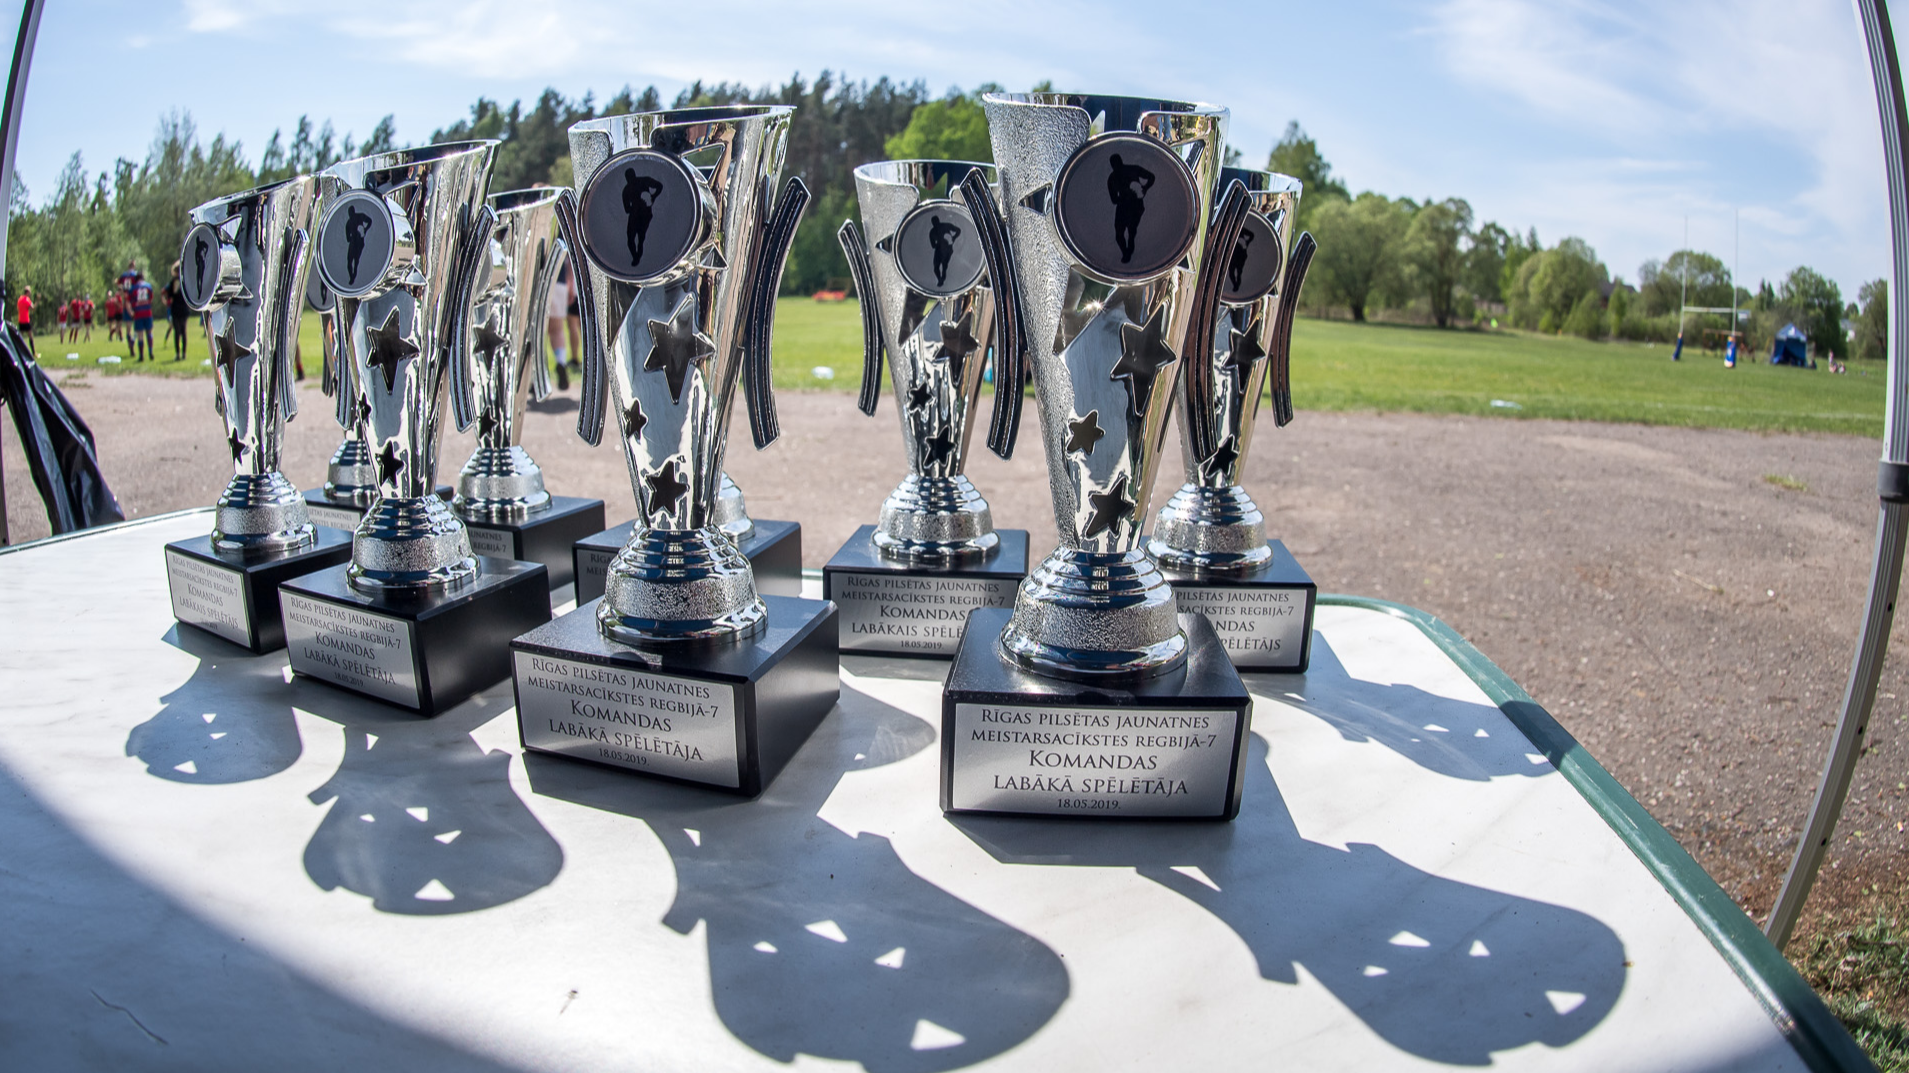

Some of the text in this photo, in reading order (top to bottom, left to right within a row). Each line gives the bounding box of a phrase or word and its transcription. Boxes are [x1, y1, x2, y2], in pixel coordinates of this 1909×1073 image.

[847, 576, 1000, 593] RĪGAS PILSĒTAS JAUNATNES
[842, 590, 1006, 608] MEISTARSACĪKSTES REGBIJĀ-7
[1176, 591, 1290, 603] PILSĒTAS JAUNATNES
[880, 605, 966, 621] KOMANDAS
[1240, 605, 1295, 618] REGBIJĀ-7
[348, 612, 395, 633] JAUNATNES
[852, 621, 918, 637] LABĀKAIS
[1215, 620, 1255, 632] NDAS
[315, 631, 375, 660] KOMANDAS
[1220, 636, 1281, 653] PĒLĒTĀJS
[304, 647, 396, 685] LABĀKĀ SPĒLĒTĀJA
[532, 657, 710, 699] RĪGAS PILSĒTAS JAUNATNES
[528, 675, 719, 719] MEISTARSACĪKSTES REGBIJĀ-7
[571, 699, 672, 732] KOMANDAS
[981, 708, 1210, 731] RĪGAS PILSĒTAS JAUNATNES
[549, 719, 704, 763] LABĀKĀ SPĒLĒTĀJA
[971, 729, 1217, 750] MEISTARSACĪKSTES REGBIJĀ-7
[1029, 750, 1158, 770] KOMANDAS
[993, 774, 1189, 799] LABĀKĀ SPĒLĒTĀJA
[1057, 798, 1122, 810] 18.05.2019.
